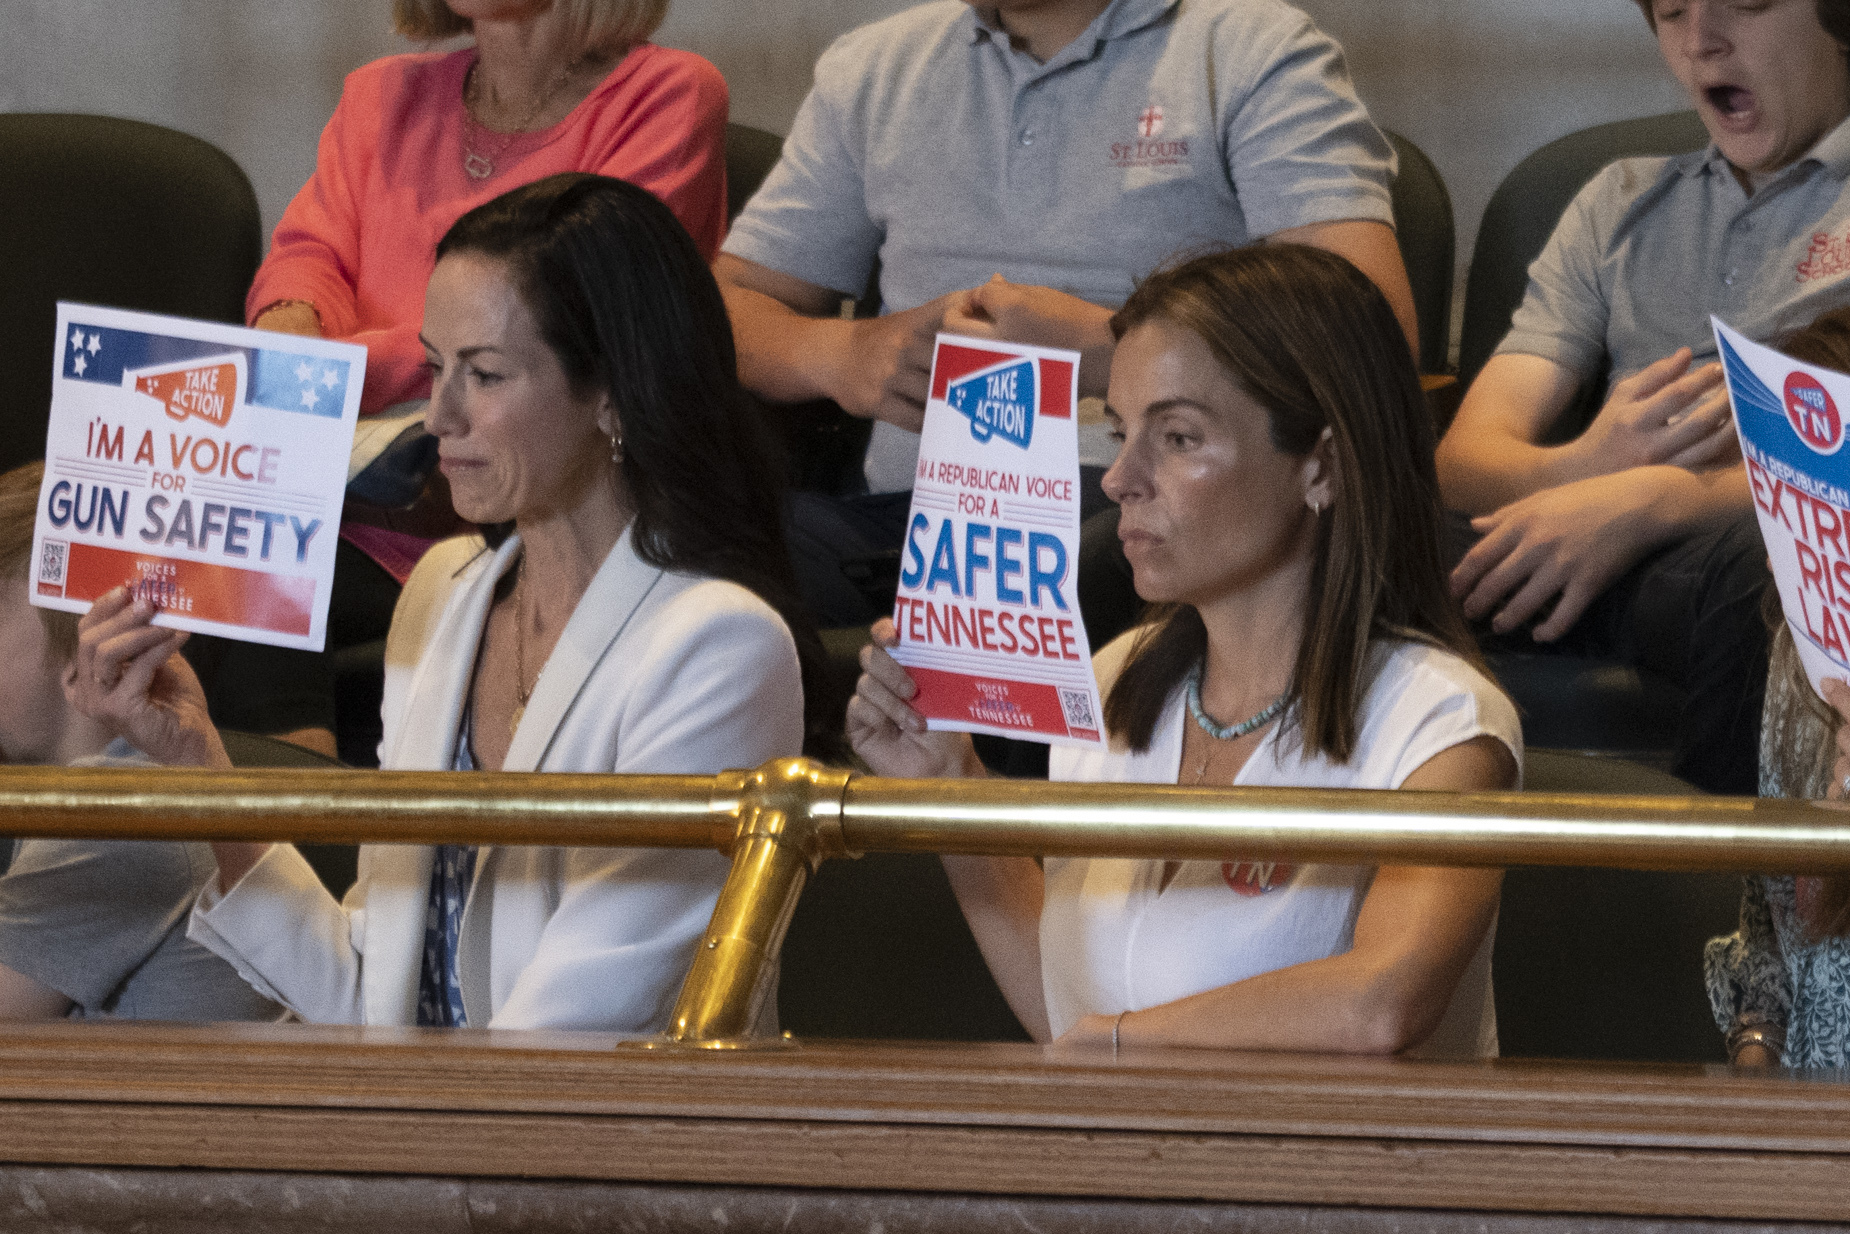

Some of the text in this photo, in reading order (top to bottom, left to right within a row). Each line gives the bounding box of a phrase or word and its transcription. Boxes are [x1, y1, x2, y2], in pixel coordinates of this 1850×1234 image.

[185, 369, 219, 391] TAKE
[986, 371, 1017, 401] TAKE
[172, 390, 224, 419] ACTION
[975, 400, 1026, 439] ACTION
[1793, 404, 1832, 443] TN
[87, 416, 281, 484] I'M A VOICE
[151, 472, 186, 493] FOR
[928, 461, 935, 482] A
[938, 463, 1020, 494] REPUBLICAN
[1026, 477, 1072, 501] VOICE
[1759, 450, 1768, 468] A
[1768, 456, 1850, 508] REPUBLICAN
[48, 480, 323, 563] GUN SAFETY
[958, 493, 1000, 520] FOR A
[136, 561, 176, 576] VOICES
[901, 512, 1071, 612] SAFER
[896, 596, 1080, 661] TENNESSEE
[975, 682, 1009, 696] VOICES
[968, 706, 1034, 727] TENNESSEE
